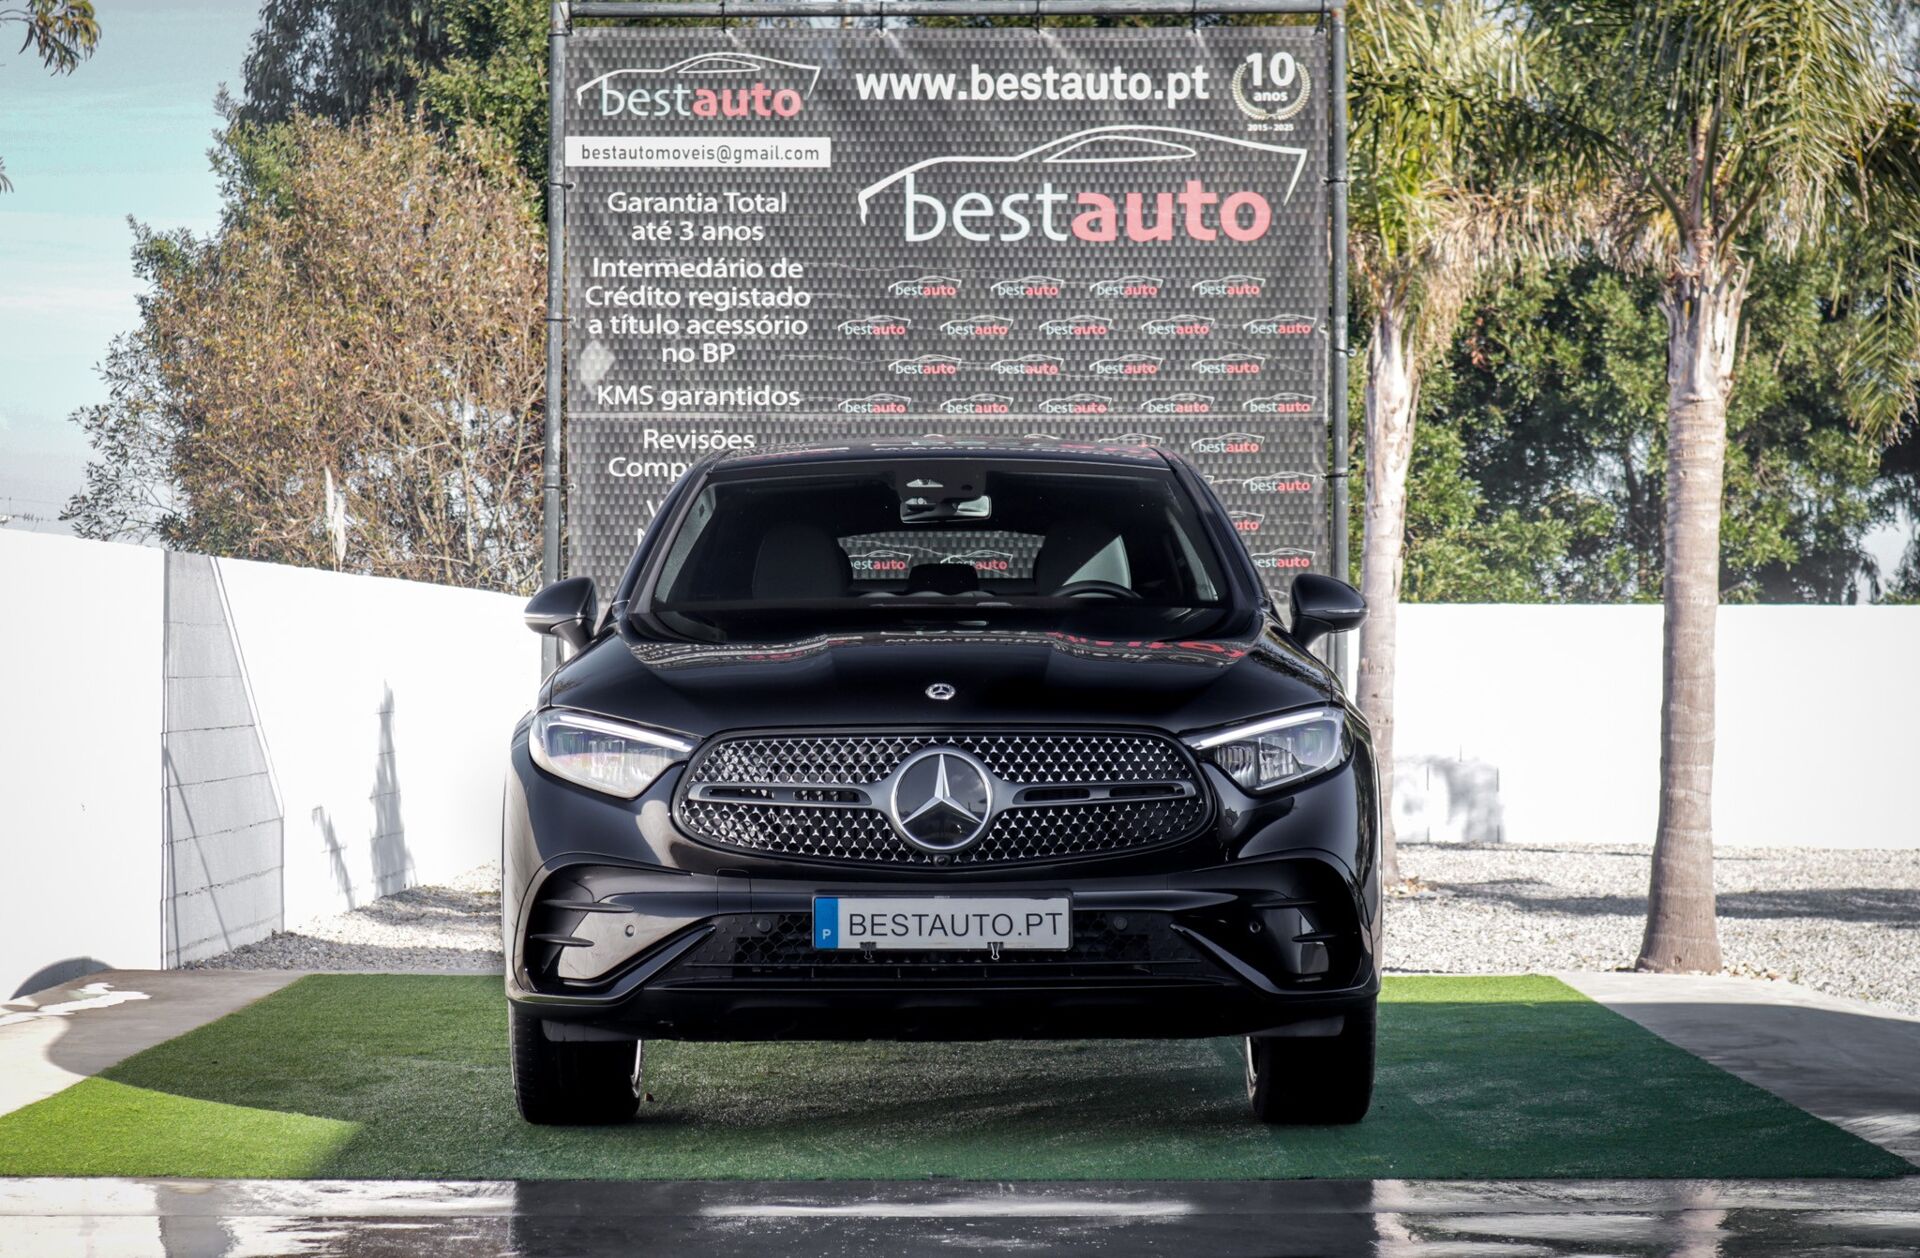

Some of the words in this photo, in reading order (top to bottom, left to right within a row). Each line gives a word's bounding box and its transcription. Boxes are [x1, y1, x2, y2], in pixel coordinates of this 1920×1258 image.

[1246, 51, 1295, 87] 10
[856, 63, 1210, 108] www.bestauto.pt
[1253, 91, 1288, 101] anos
[601, 77, 803, 117] bestauto
[581, 144, 819, 164] bestautomoveis@gmail.com
[607, 192, 718, 213] Garantia
[724, 192, 787, 213] Total
[905, 173, 1272, 242] bestauto
[631, 220, 672, 241] até
[680, 222, 694, 241] 3
[702, 225, 764, 241] anos
[592, 257, 763, 278] Intermedário
[770, 257, 804, 278] de
[585, 285, 681, 306] Crédito
[689, 286, 811, 311] registado
[895, 284, 957, 297] bestauto
[997, 284, 1059, 297] bestauto
[1097, 284, 1158, 297] bestauto
[1199, 284, 1261, 296] bestauto
[589, 320, 603, 335] a
[609, 314, 680, 335] título
[687, 315, 808, 335] acessório
[845, 323, 906, 336] bestauto
[947, 323, 1009, 336] bestauto
[1046, 323, 1108, 336] bestauto
[1148, 323, 1210, 335] bestauto
[1250, 323, 1312, 335] bestauto
[662, 347, 695, 363] no
[703, 343, 736, 363] BP
[895, 363, 957, 376] bestauto
[997, 363, 1059, 376] bestauto
[1096, 363, 1158, 375] bestauto
[1199, 363, 1260, 375] bestauto
[597, 385, 654, 406] KMS
[661, 385, 801, 410] garantidos
[845, 402, 907, 415] bestauto
[947, 402, 1009, 415] bestauto
[1046, 402, 1108, 415] bestauto
[1147, 402, 1210, 414] bestauto
[1249, 402, 1312, 413] bestauto
[643, 428, 755, 450] Revisões
[1198, 441, 1260, 453] bestauto
[608, 456, 693, 482] Comp
[1250, 479, 1311, 492] bestauto
[822, 928, 832, 940] P
[849, 912, 1063, 937] BESTAUTO.PT
